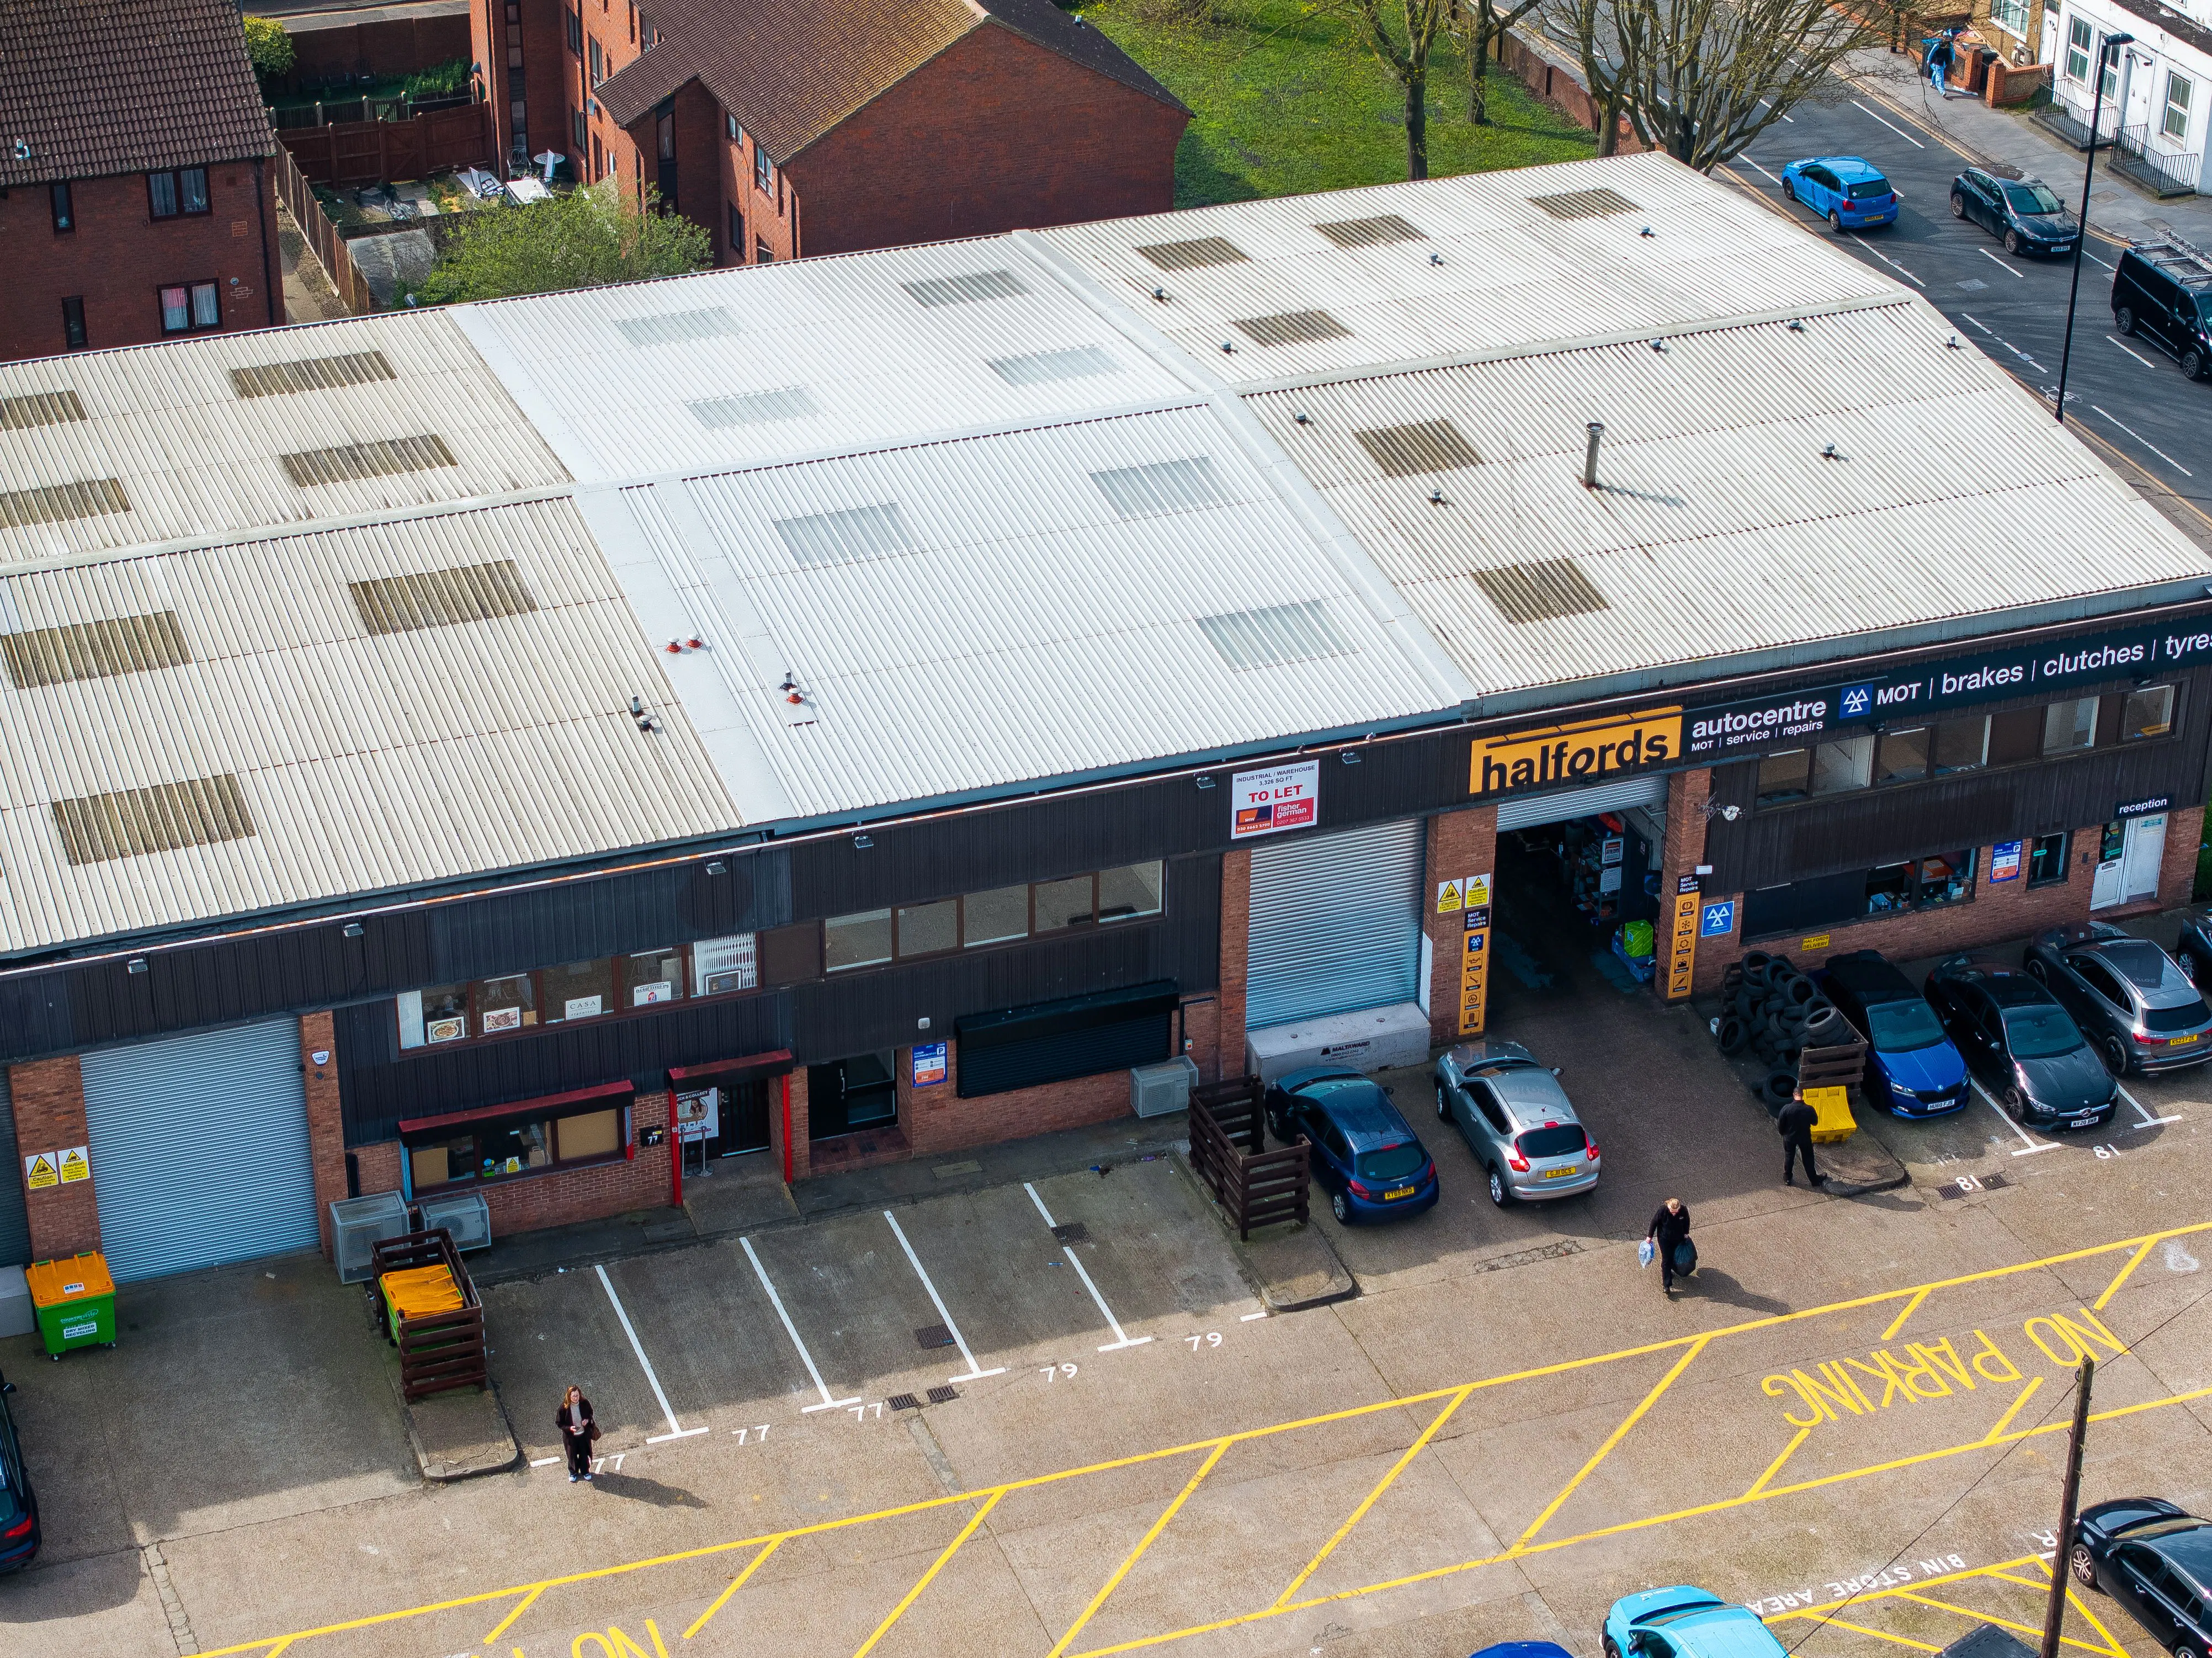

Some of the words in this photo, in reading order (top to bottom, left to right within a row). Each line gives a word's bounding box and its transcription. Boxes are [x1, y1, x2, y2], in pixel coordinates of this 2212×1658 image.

[1877, 682, 1921, 705] MOT
[1941, 665, 2023, 694] brakes
[2043, 644, 2144, 677] clutches
[1692, 700, 1826, 738] autocentre
[1691, 740, 1714, 751] MOT
[1726, 729, 1770, 745] service
[1783, 720, 1823, 736] repairs
[1482, 729, 1668, 791] halfords
[1236, 772, 1273, 783] INDUSTRIAL
[1277, 765, 1315, 776] WAREHOUSE
[1248, 791, 1269, 803] TO
[1275, 784, 1302, 799] LET
[1277, 807, 1307, 819] german
[1278, 804, 1300, 812] fisher
[2119, 798, 2167, 814] reception
[570, 1000, 595, 1009] CASA
[1332, 1041, 1370, 1052] MALTAWARD
[648, 1135, 658, 1145] 77
[2093, 1143, 2121, 1160] 81
[1955, 1175, 1982, 1191] 81
[65, 1328, 95, 1337] RECYCLING
[1184, 1332, 1222, 1351] 79
[2024, 1308, 2131, 1367] NO
[1039, 1363, 1078, 1383] 79
[1761, 1329, 2023, 1427] PARKING
[848, 1402, 884, 1422] 77
[732, 1424, 771, 1446] 77
[591, 1454, 626, 1474] 77
[1919, 1553, 1966, 1575] BIN
[1824, 1566, 1912, 1597] STORE
[1744, 1588, 1813, 1615] AREA
